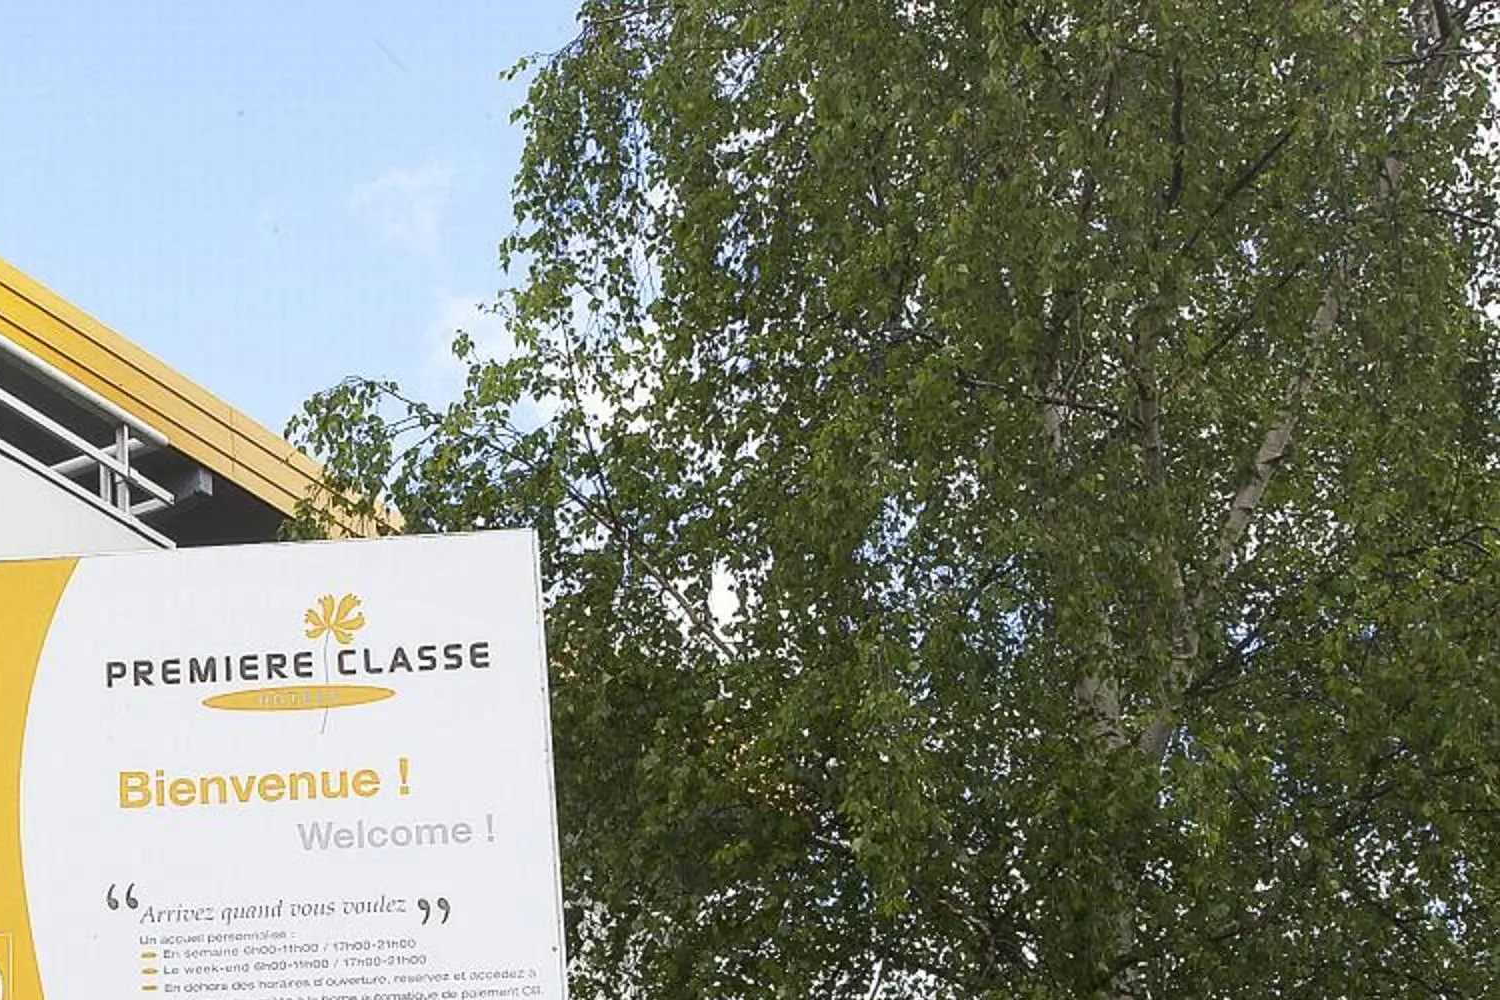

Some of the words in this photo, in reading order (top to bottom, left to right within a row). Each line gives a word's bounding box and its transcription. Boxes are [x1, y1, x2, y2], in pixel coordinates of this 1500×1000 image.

[106, 651, 314, 689] PREMIERE
[337, 641, 492, 676] CLASSE
[119, 767, 382, 809] Bienvenue
[398, 758, 410, 796] !
[297, 819, 473, 851] Welcome
[139, 903, 215, 925] Arrivez
[221, 899, 283, 926] quand
[290, 899, 336, 917] vous
[343, 894, 407, 915] voulez
[184, 947, 239, 959] semaine
[184, 962, 250, 975] week-end
